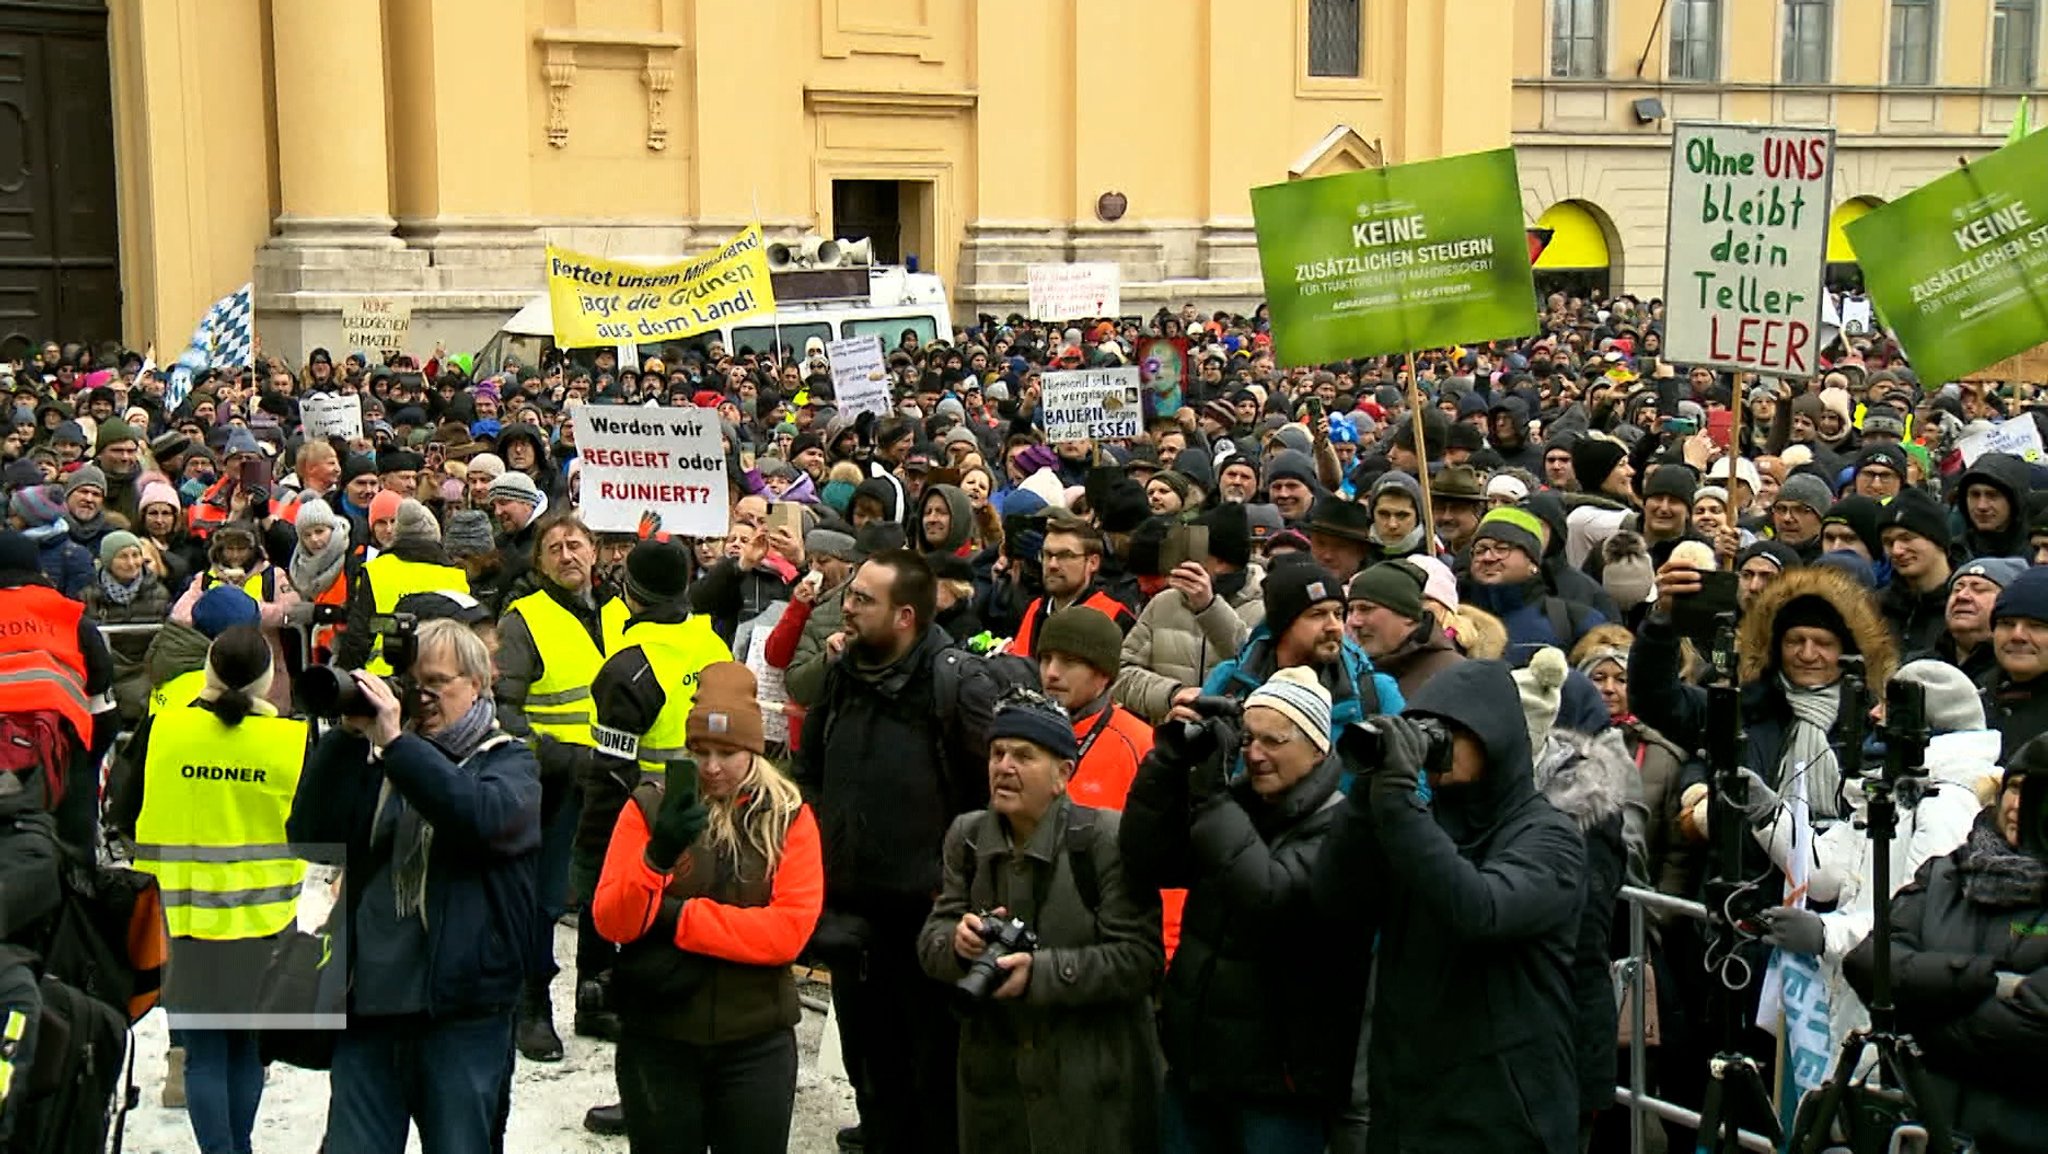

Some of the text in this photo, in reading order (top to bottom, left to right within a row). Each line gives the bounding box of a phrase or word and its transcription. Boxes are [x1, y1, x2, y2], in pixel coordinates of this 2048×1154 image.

[1686, 136, 1826, 182] Ohne UNS
[1702, 183, 1805, 231] bleibt
[1953, 200, 2032, 252] KEINE
[1352, 215, 1427, 248] KEINE
[1710, 229, 1788, 268] dein
[552, 257, 612, 287] Rettet
[617, 271, 679, 288] unsren
[1295, 238, 1494, 282] ZUSÄTZLICHEN STEUERN
[1910, 238, 2028, 302] ZUSÄTZLICHEN
[576, 263, 755, 318] jagt die Grünen
[1694, 271, 1805, 316] Teller
[597, 288, 758, 340] aus dem Land!
[1709, 314, 1809, 373] LEER
[590, 417, 703, 438] Werden wir
[1045, 407, 1103, 425] BAUERN
[1088, 421, 1136, 438] ESSEN
[583, 448, 723, 472] REGIERT oder
[600, 481, 710, 504] RUINIERT?
[181, 765, 267, 783] ORDNER
